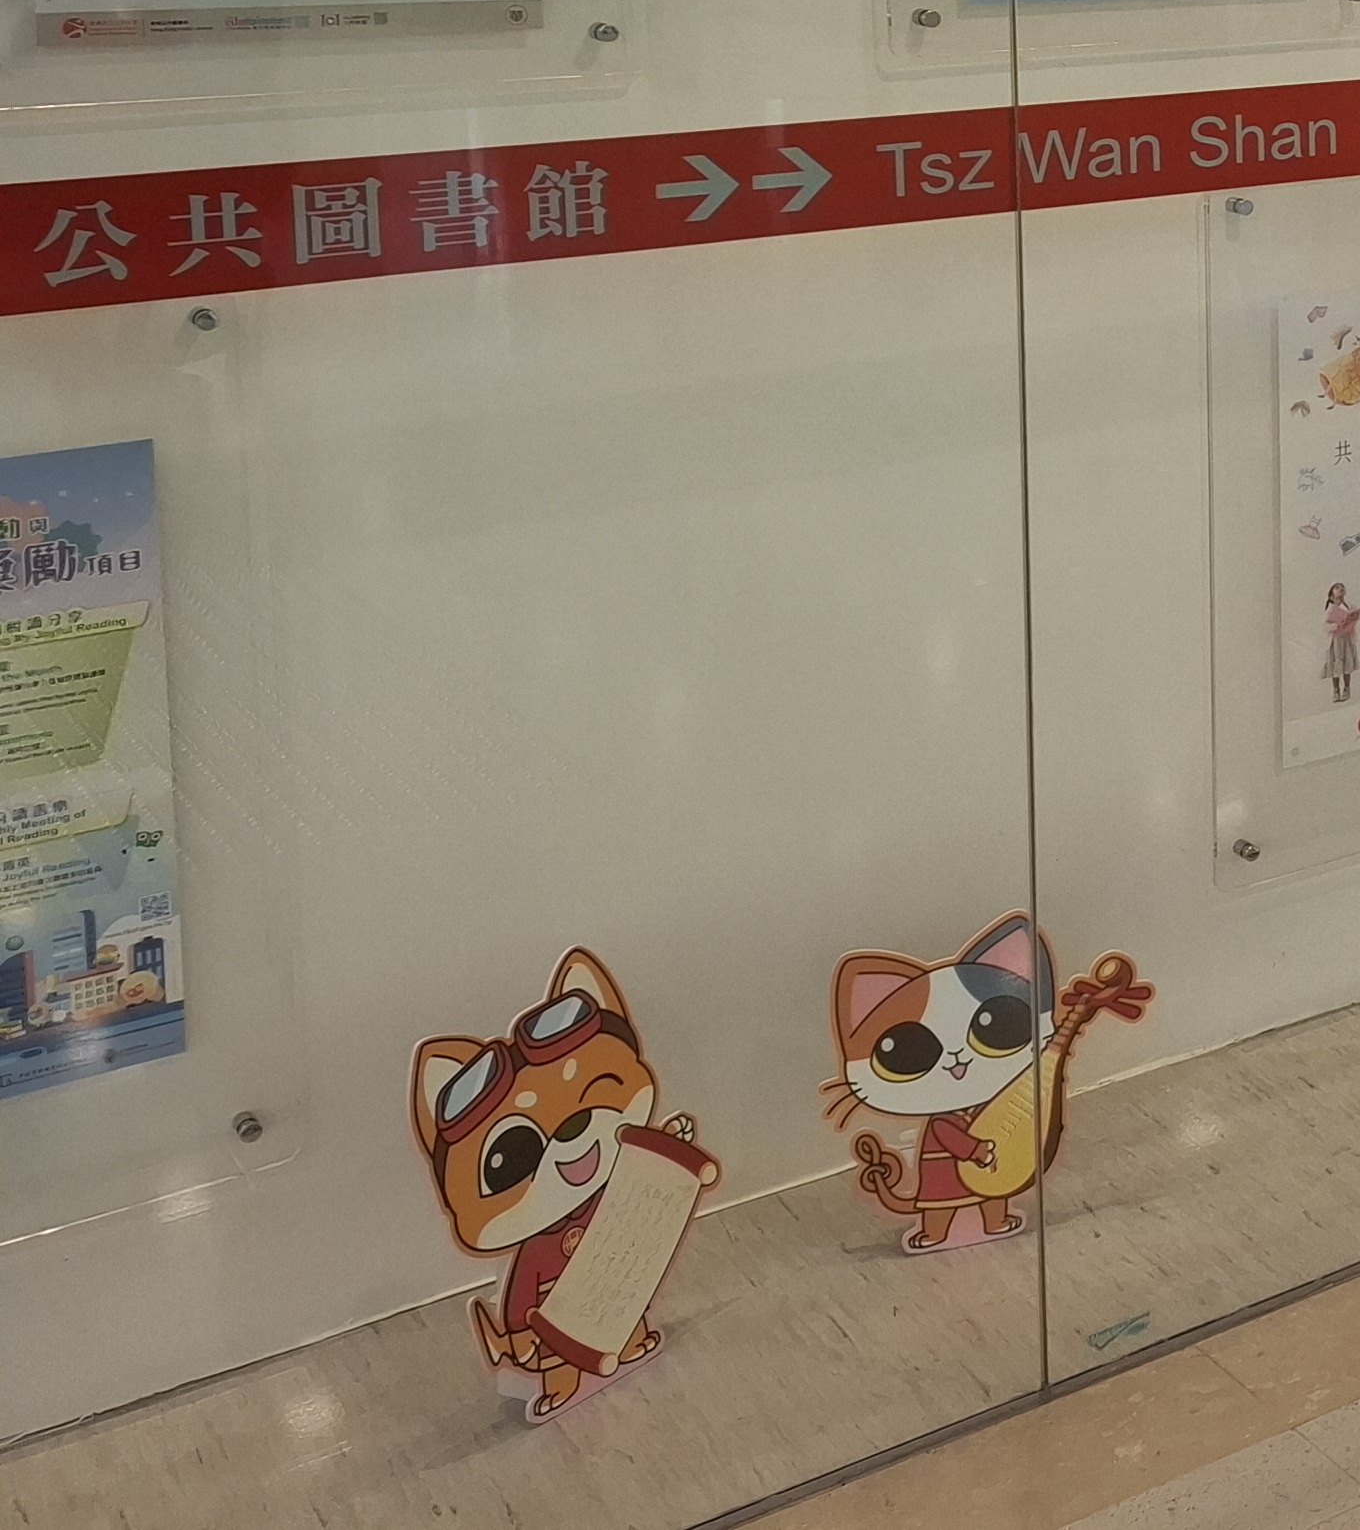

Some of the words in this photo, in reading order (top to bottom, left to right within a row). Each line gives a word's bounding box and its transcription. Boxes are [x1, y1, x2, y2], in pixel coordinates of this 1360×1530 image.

[875, 140, 996, 198] Tsz
[1016, 126, 1163, 184] Wan
[1188, 112, 1340, 169] Shan
[32, 159, 611, 290] 公共圖書館
[76, 617, 127, 633] Reading
[73, 808, 87, 820] of
